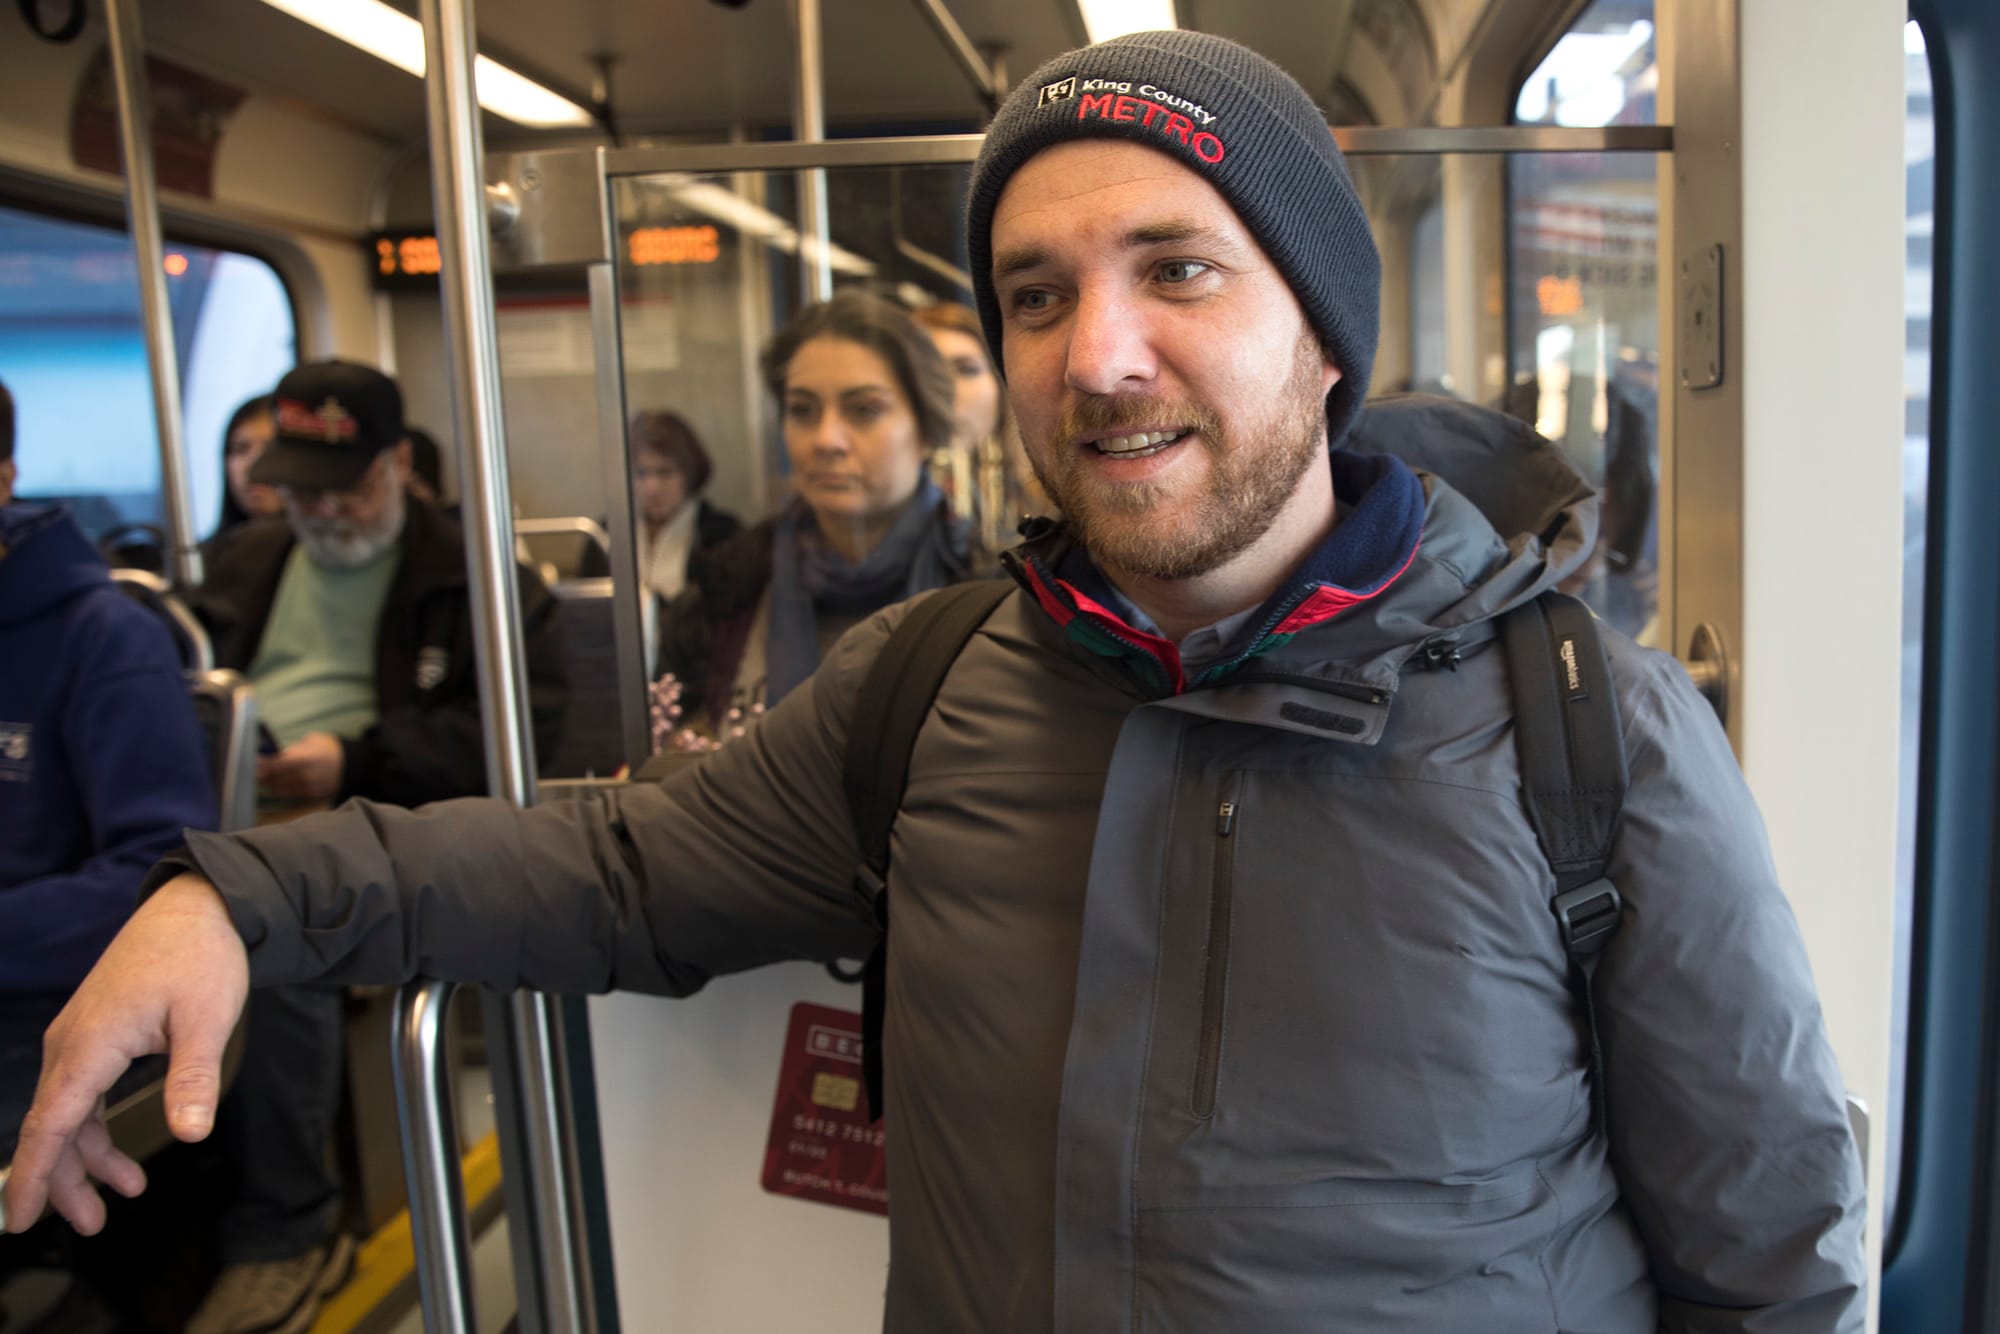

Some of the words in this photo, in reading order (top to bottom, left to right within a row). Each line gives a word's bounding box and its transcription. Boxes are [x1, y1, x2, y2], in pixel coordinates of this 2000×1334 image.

[1077, 93, 1225, 163] METRO
[1082, 79, 1132, 94] King
[1139, 84, 1217, 125] County
